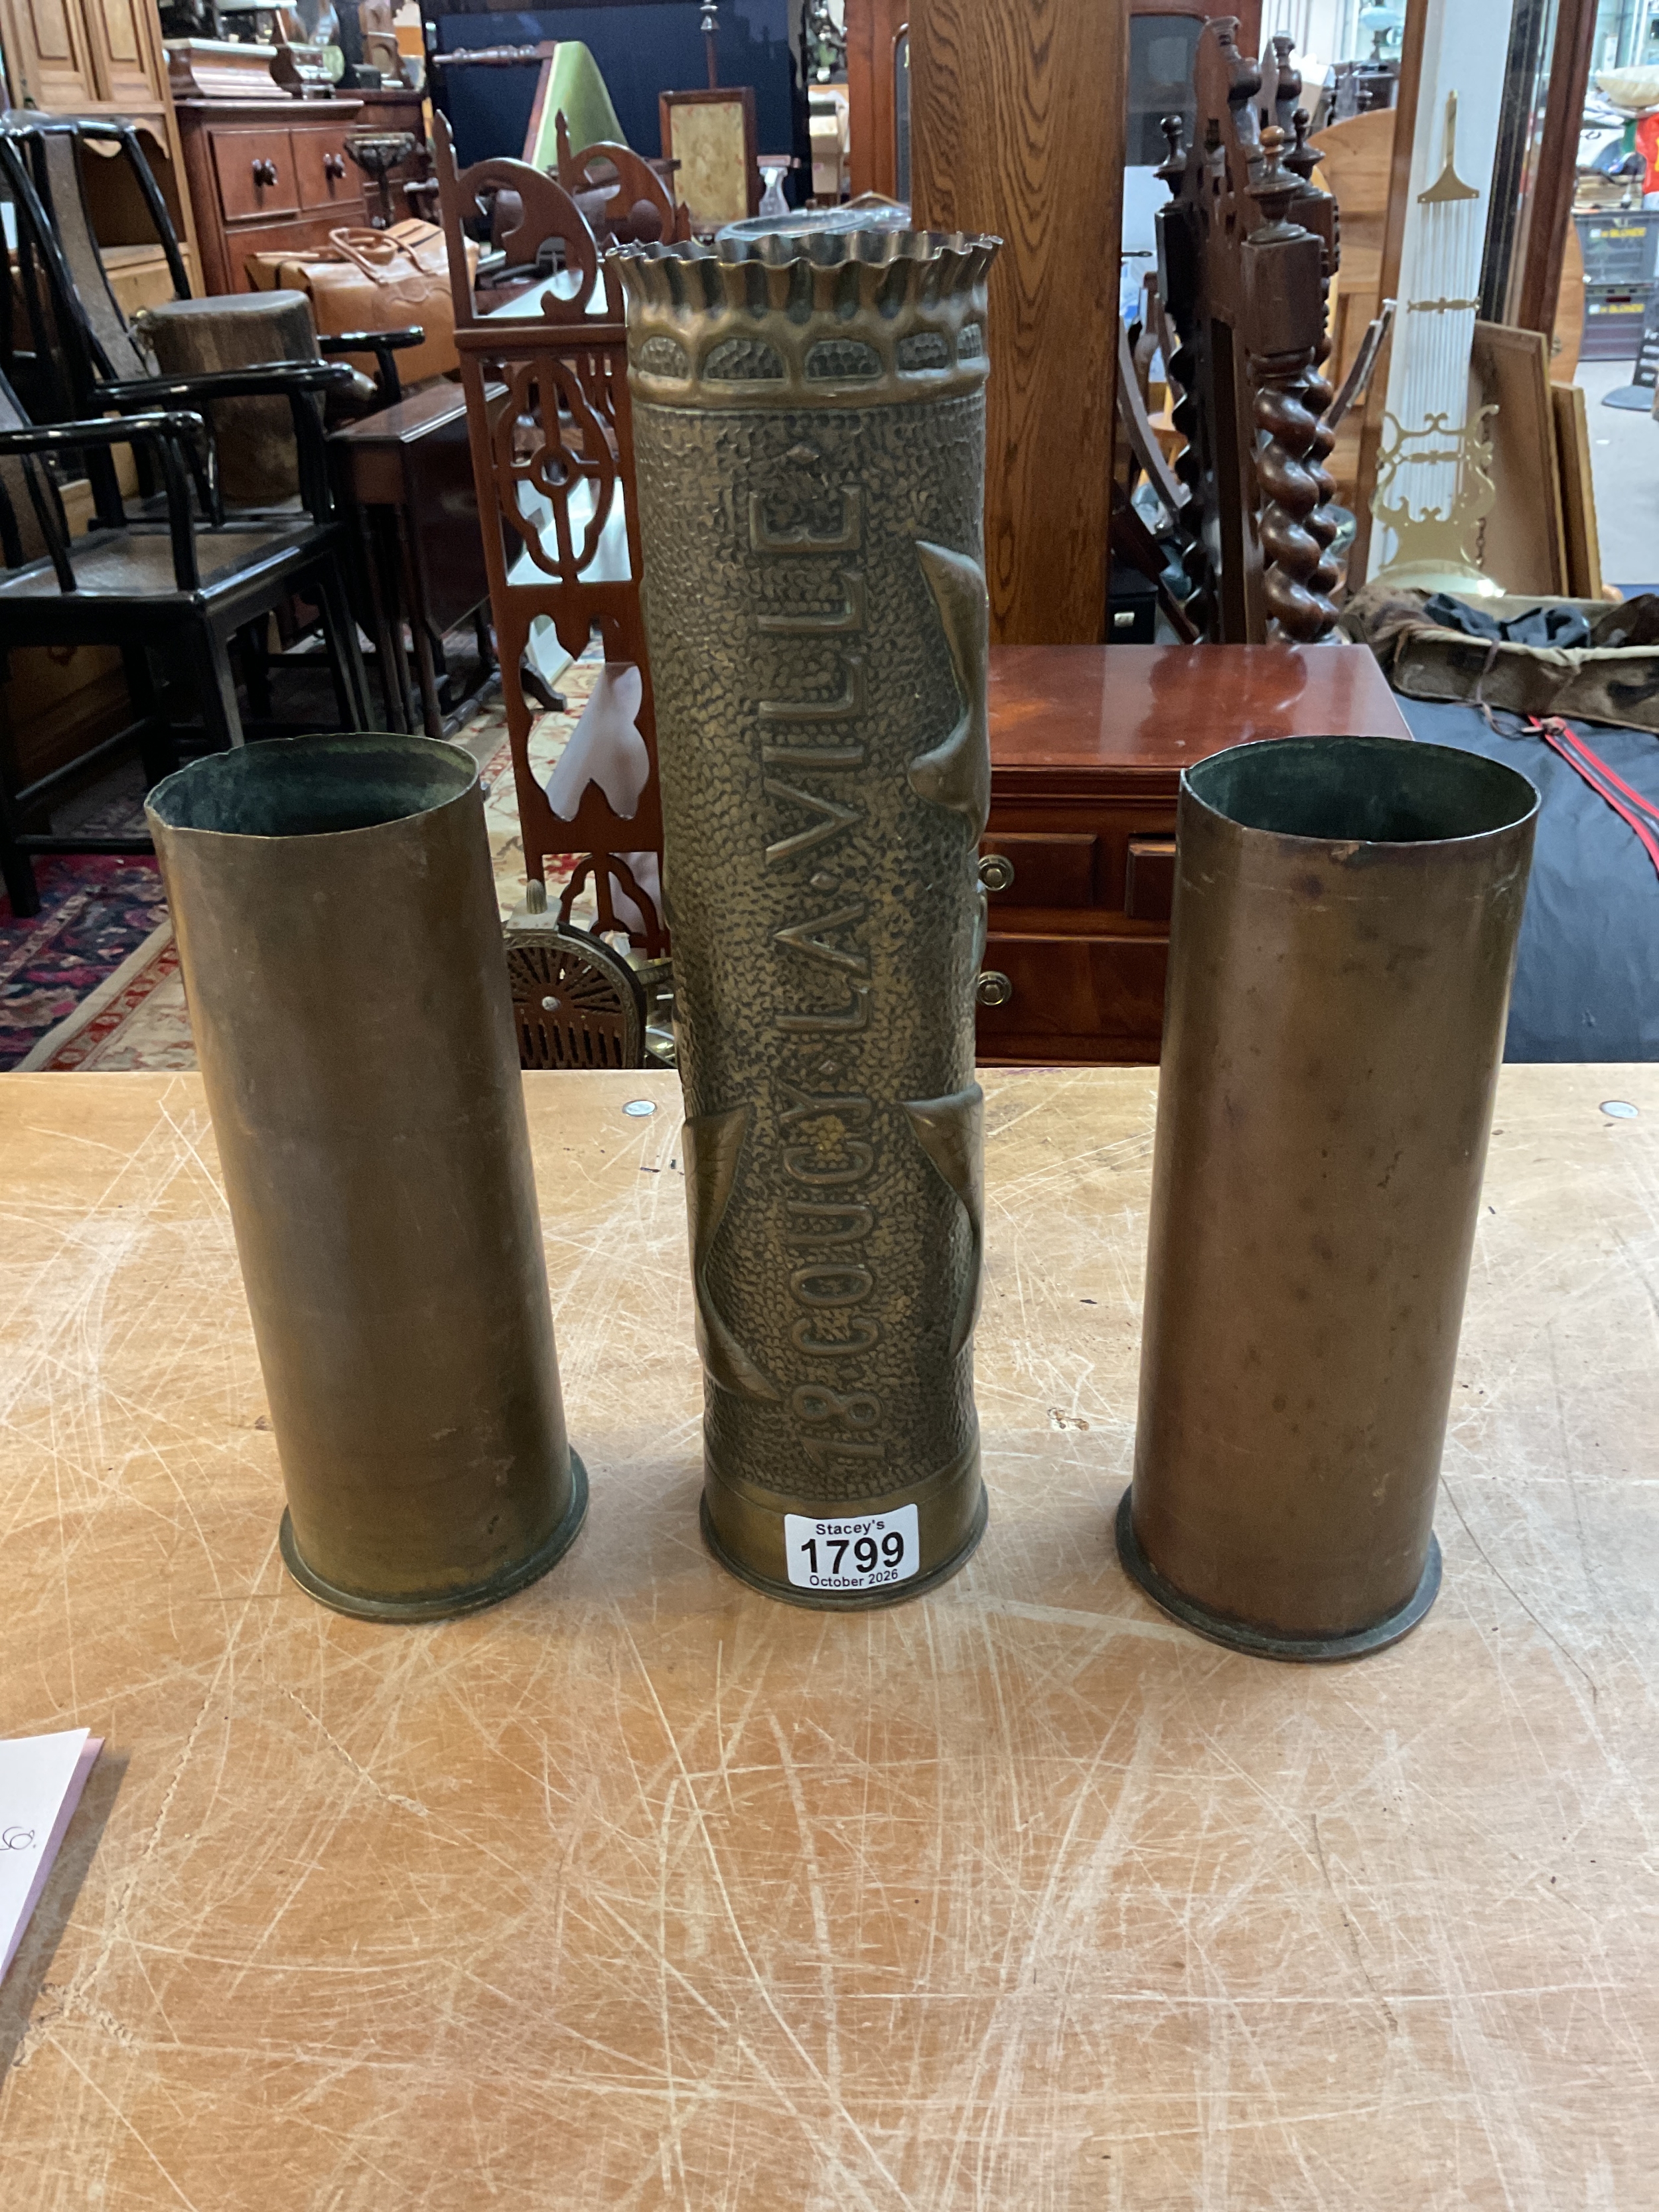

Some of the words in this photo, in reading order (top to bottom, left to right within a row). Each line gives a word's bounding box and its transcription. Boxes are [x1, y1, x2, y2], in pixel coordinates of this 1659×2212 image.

[793, 1384, 885, 1467] 18
[816, 1520, 885, 1535] Stacey's
[801, 1532, 904, 1574] 1799
[809, 1575, 865, 1587] October
[868, 1569, 898, 1585] 2026
